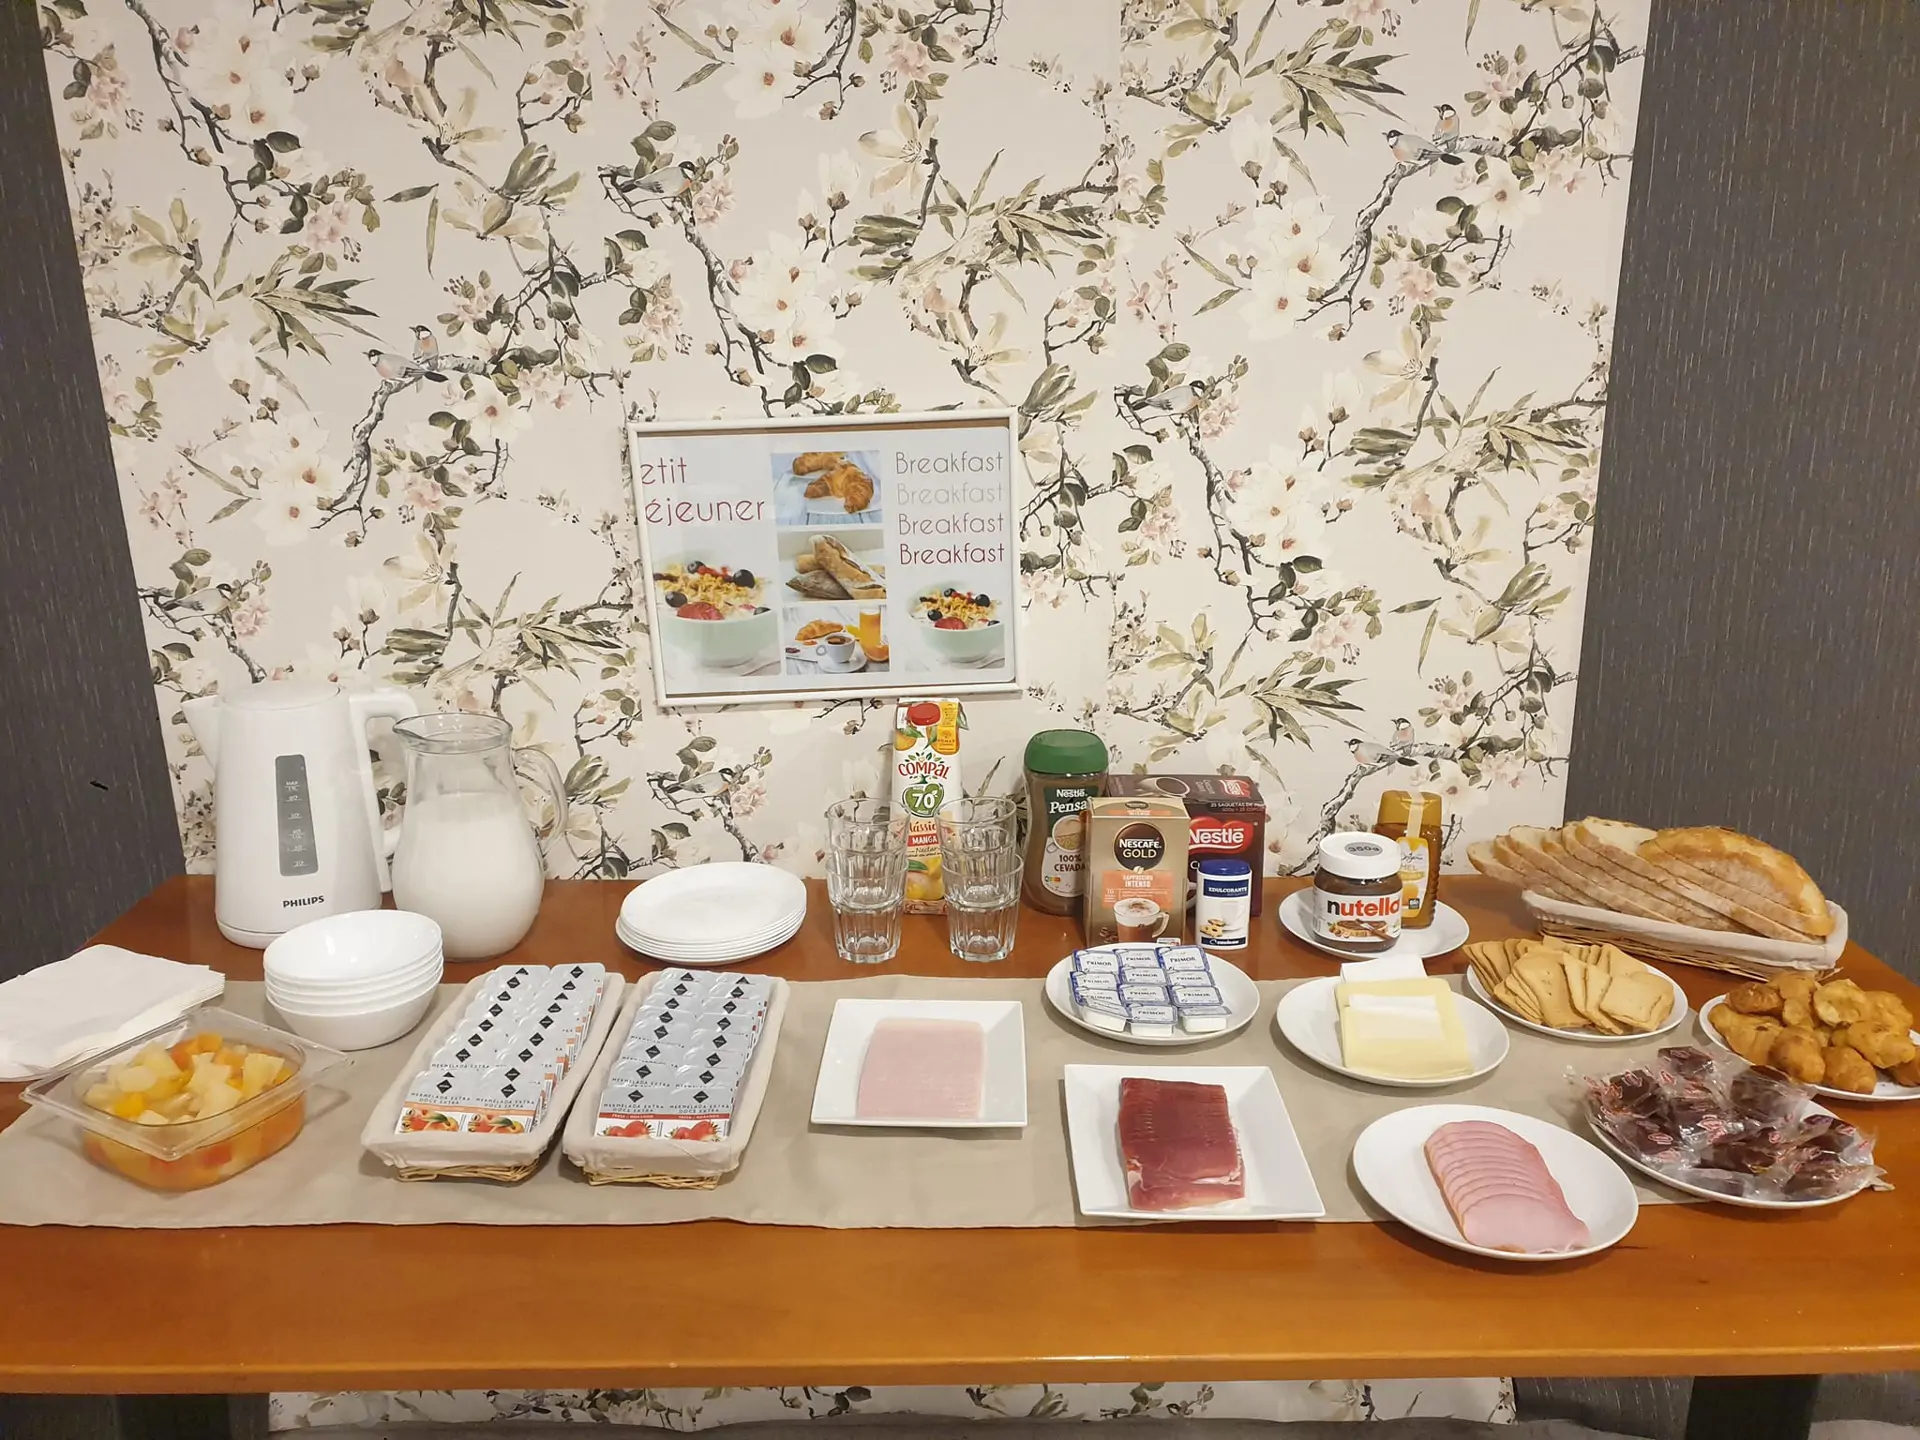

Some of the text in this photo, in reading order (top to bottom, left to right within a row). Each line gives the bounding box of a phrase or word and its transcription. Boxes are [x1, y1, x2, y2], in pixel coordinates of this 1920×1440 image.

[895, 450, 1004, 475] Breakfast
[640, 456, 687, 485] etit
[896, 481, 1004, 506] Breakfast
[644, 497, 765, 527] éjeuner
[898, 511, 1005, 536] Breakfast
[900, 541, 1005, 566] Breakfast
[1056, 788, 1086, 798] Nestlé
[912, 793, 935, 809] 70
[909, 821, 936, 833] lássic
[911, 835, 938, 845] MANGA
[1189, 828, 1245, 844] Nestlé
[1122, 849, 1157, 858] GOLD
[1347, 845, 1380, 853] 350g
[1058, 854, 1082, 863] 100%
[1053, 863, 1086, 872] CEVADA
[1125, 880, 1151, 888] INTENSO
[282, 895, 325, 908] PHILIPS
[1326, 897, 1400, 917] nutella
